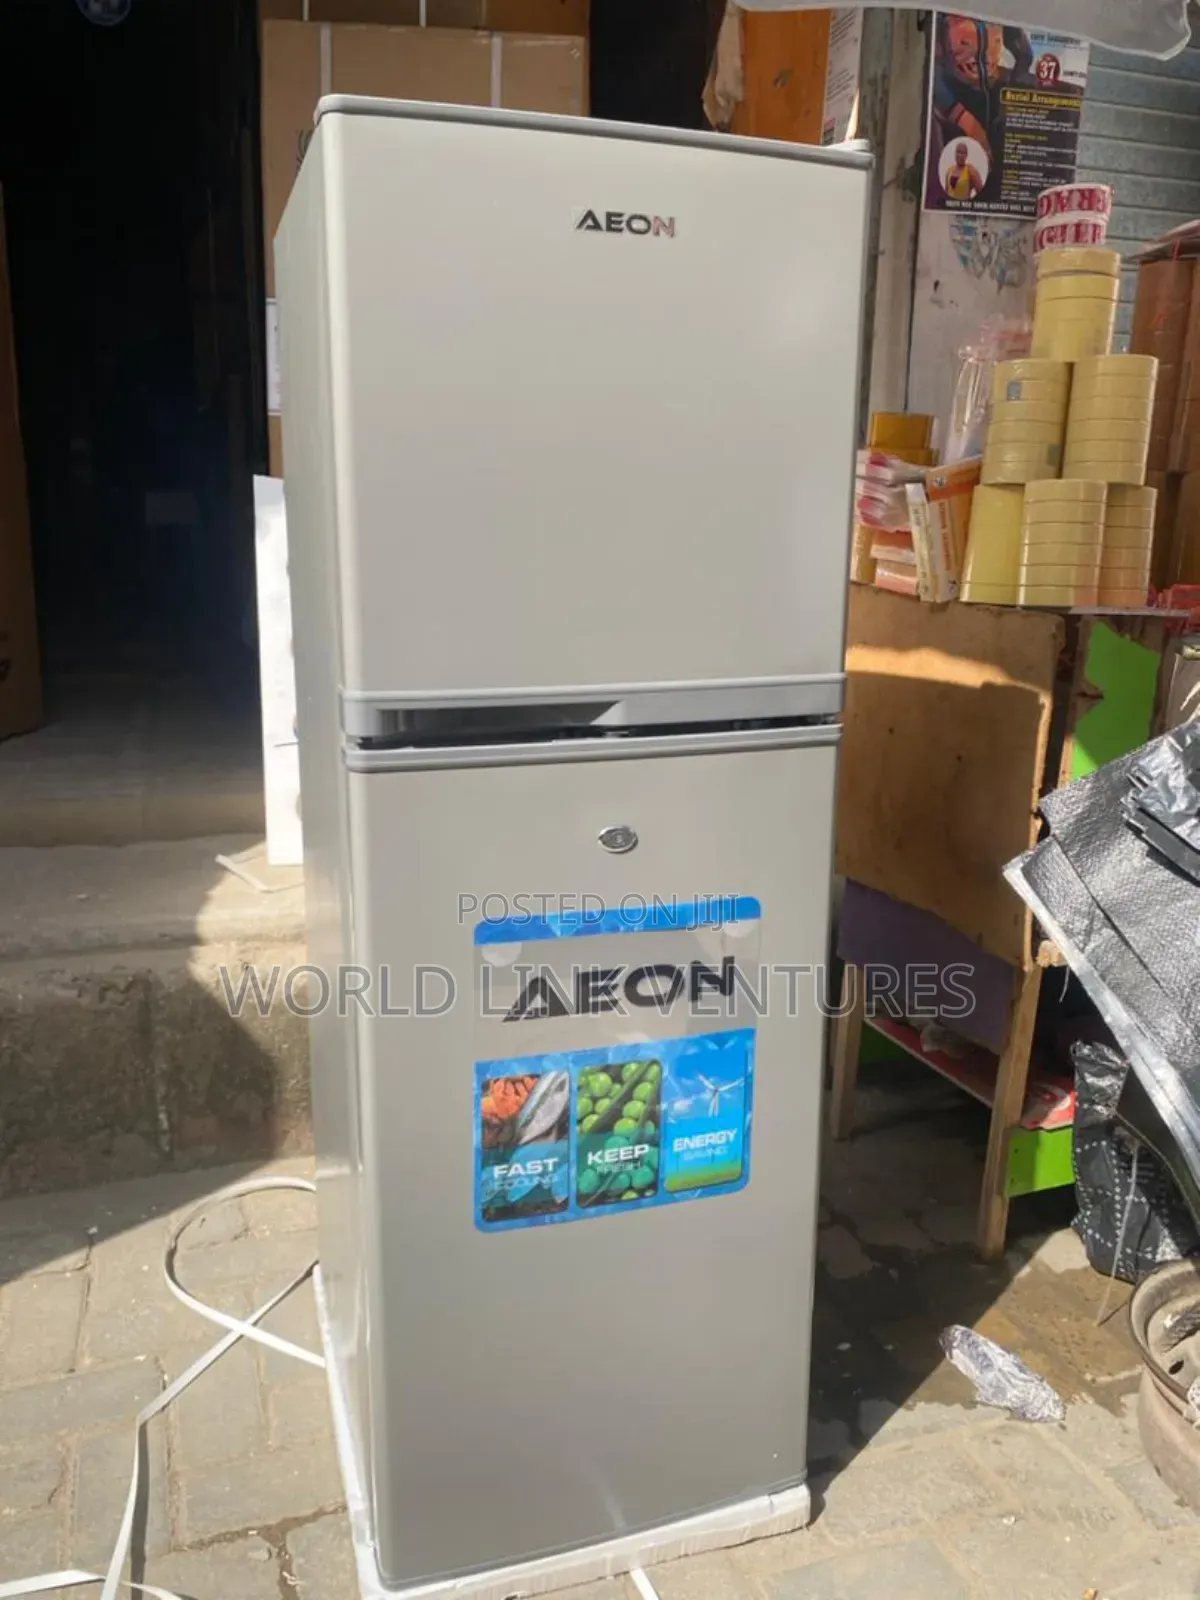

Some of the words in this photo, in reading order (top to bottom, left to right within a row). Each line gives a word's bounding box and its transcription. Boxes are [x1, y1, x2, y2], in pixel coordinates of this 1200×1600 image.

[1040, 60, 1057, 80] 37
[576, 209, 676, 238] AEON
[501, 955, 735, 1022] AEON
[673, 1128, 738, 1152] ENERGY
[587, 1144, 649, 1166] KEEP
[494, 1157, 559, 1179] FAST
